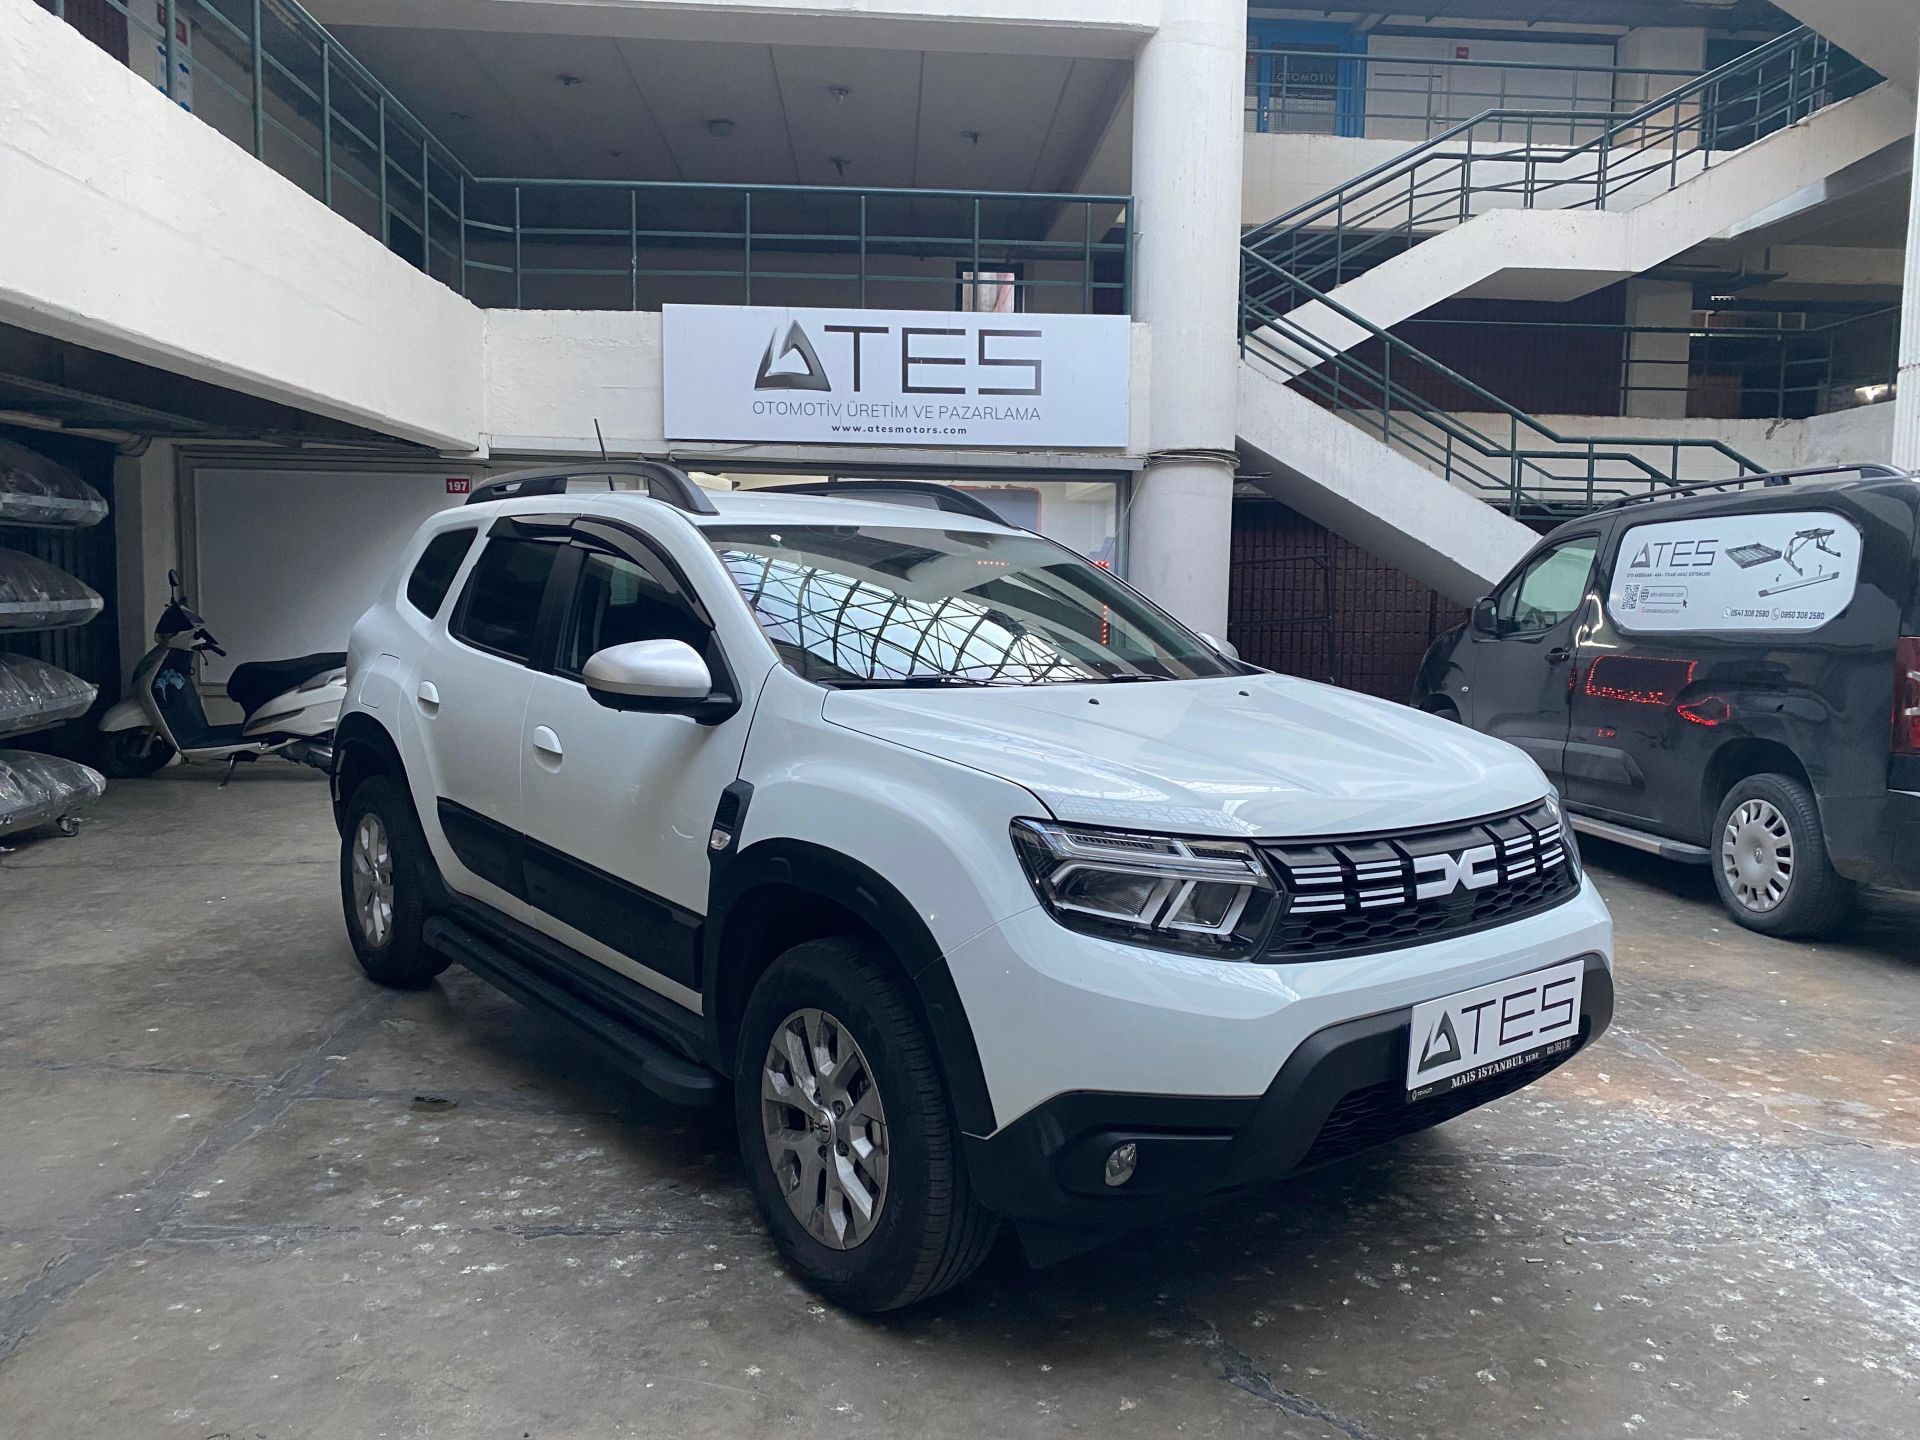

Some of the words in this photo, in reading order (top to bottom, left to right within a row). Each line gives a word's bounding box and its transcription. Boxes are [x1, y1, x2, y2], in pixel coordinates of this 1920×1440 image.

[754, 319, 1042, 396] ATES
[752, 399, 842, 418] OTOMOTİV
[847, 401, 908, 419] ÜRETİM
[915, 405, 936, 420] VE
[939, 405, 1042, 421] PAZARLAMA
[831, 423, 967, 435] www.atesmotors.com
[448, 481, 467, 491] 197
[1630, 539, 1719, 569] ATES
[1730, 609, 1744, 617] 0541
[1744, 609, 1755, 617] 308
[1755, 610, 1770, 618] 2580
[1796, 611, 1808, 619] 308
[1808, 612, 1825, 620] 2580
[1417, 976, 1576, 1076] ATES
